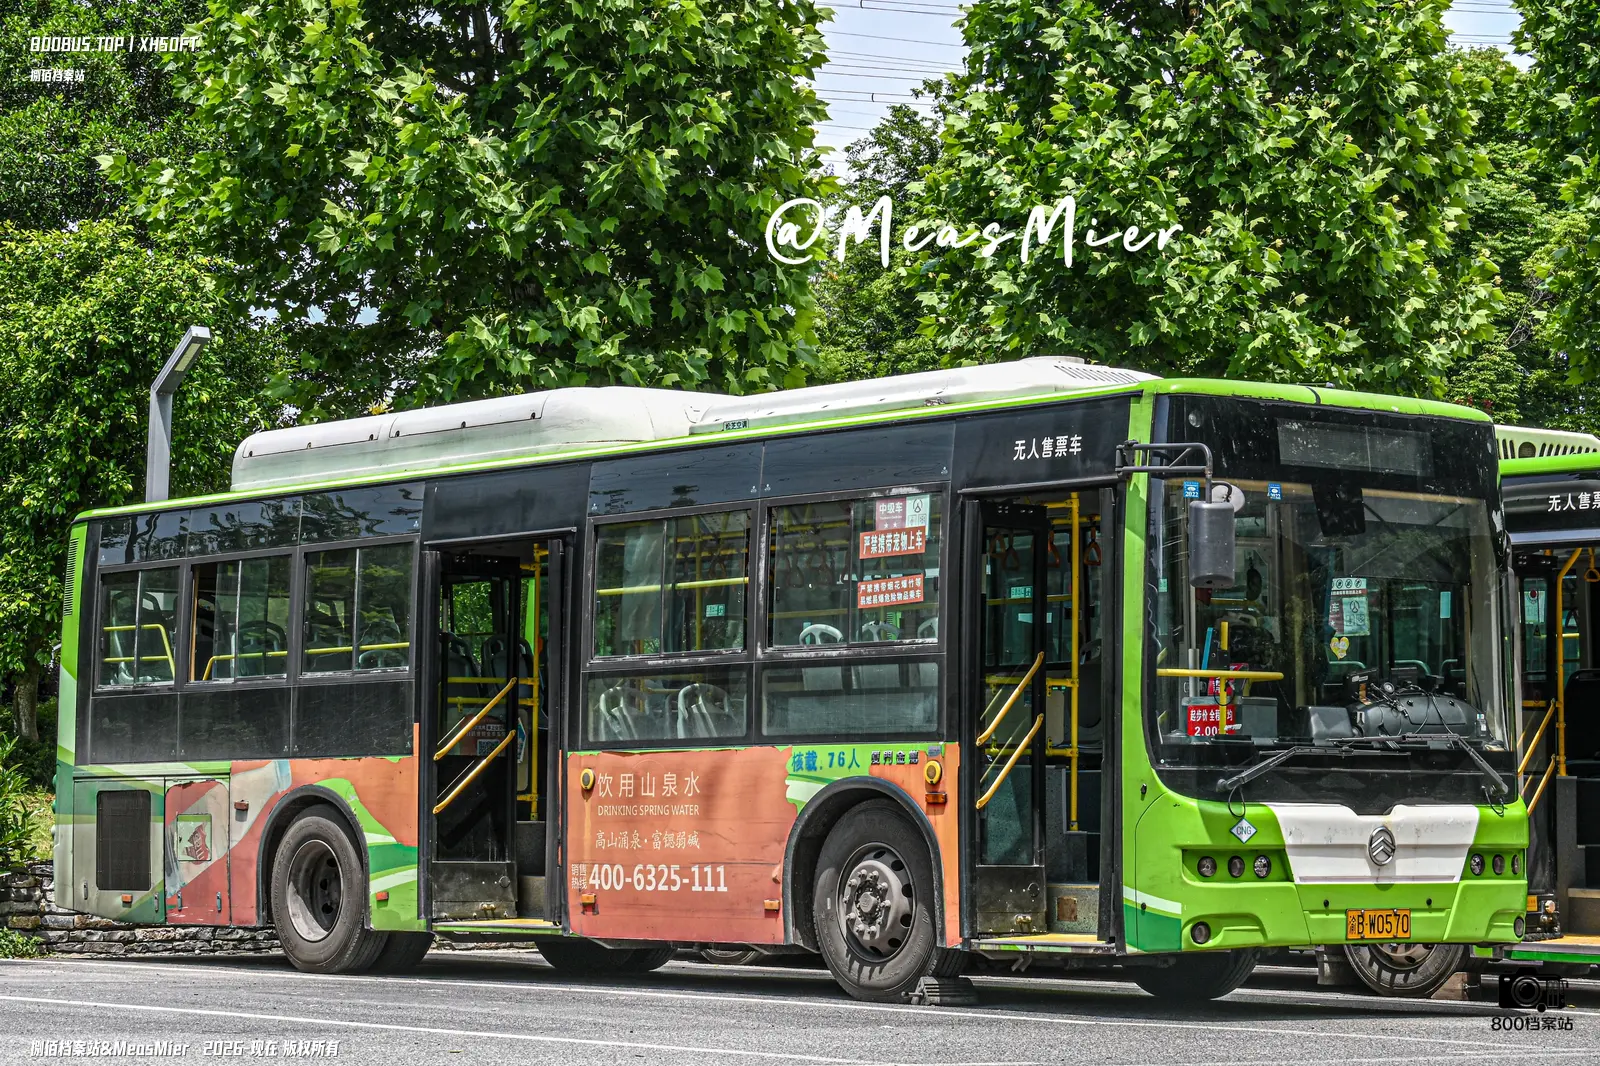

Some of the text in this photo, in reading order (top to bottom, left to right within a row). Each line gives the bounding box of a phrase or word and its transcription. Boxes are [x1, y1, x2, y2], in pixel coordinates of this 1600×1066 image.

[1012, 434, 1082, 461] 无人售票车
[863, 529, 923, 555] 严禁携带宠物上车
[597, 770, 701, 799] 饮用山泉水
[597, 804, 700, 817] DRINKING SPRING WATER
[1236, 825, 1252, 836] CNG
[588, 863, 729, 893] 400-6325-111
